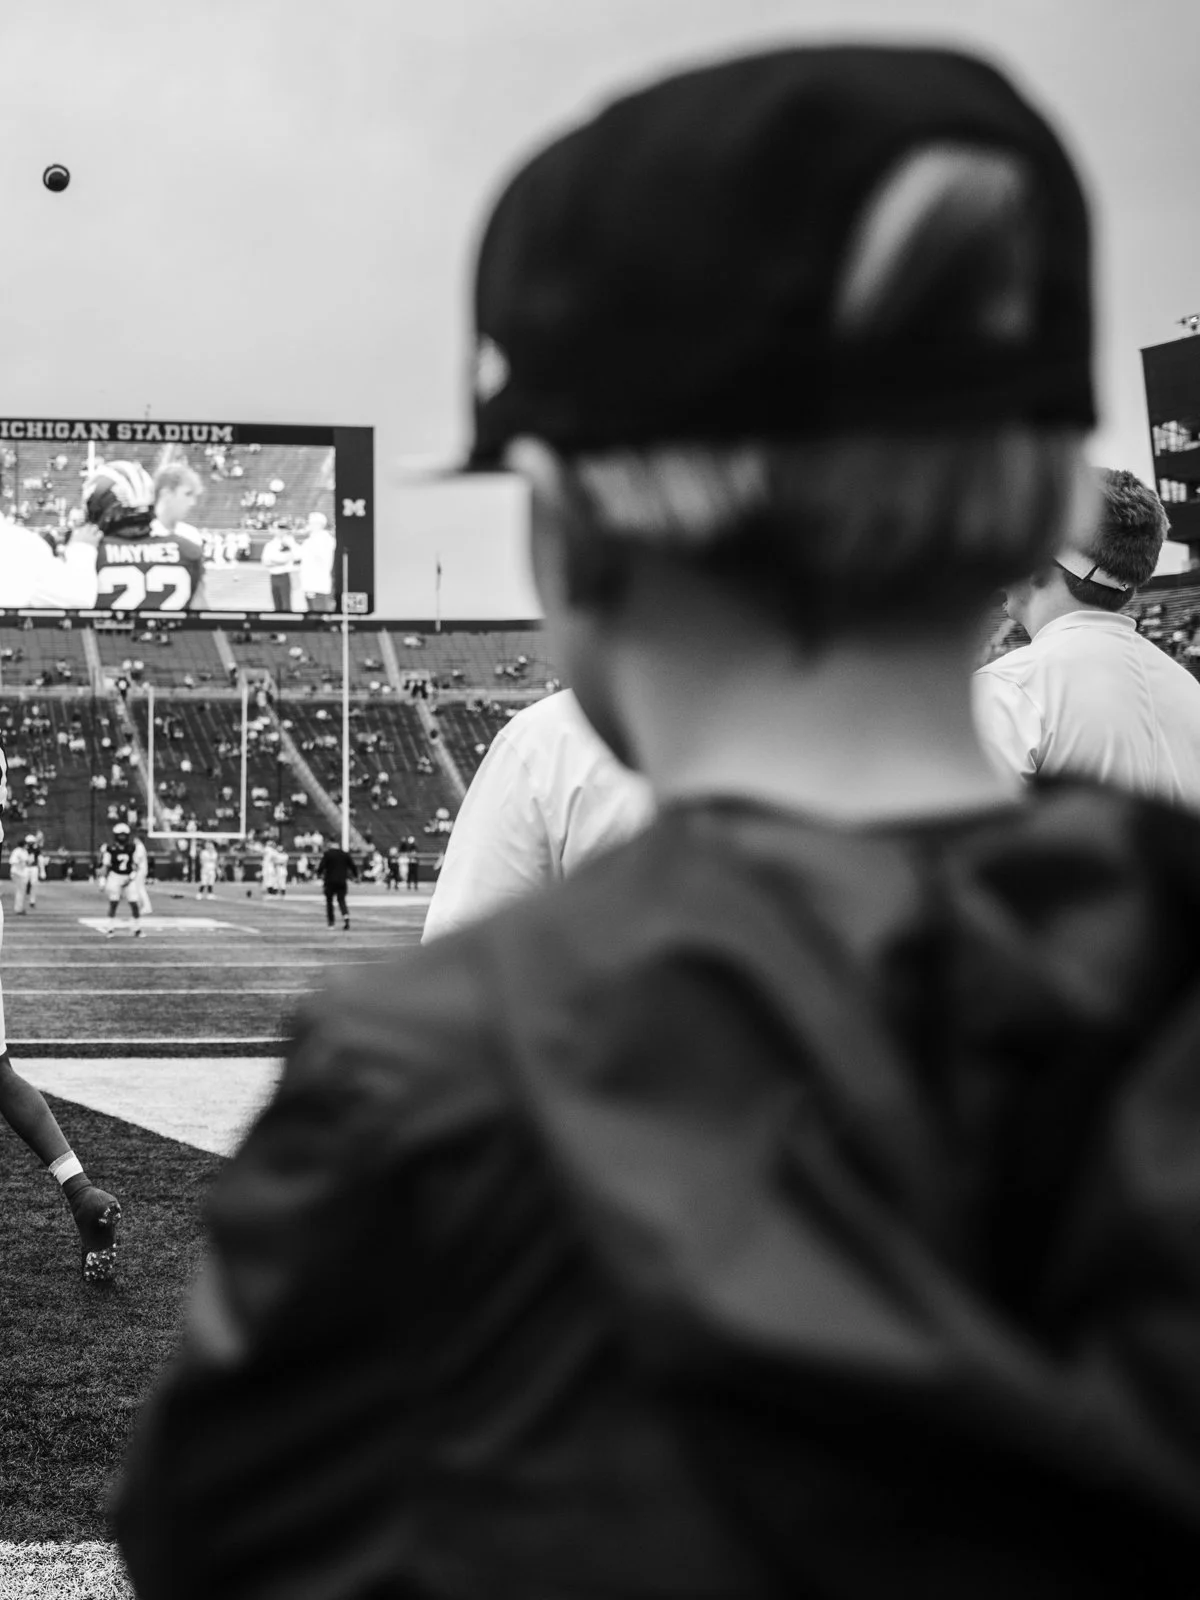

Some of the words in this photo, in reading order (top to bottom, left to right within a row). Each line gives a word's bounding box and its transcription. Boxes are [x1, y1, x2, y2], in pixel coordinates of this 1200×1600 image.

[117, 423, 233, 442] STADIUM
[342, 498, 366, 517] M
[105, 542, 180, 564] HAYNES
